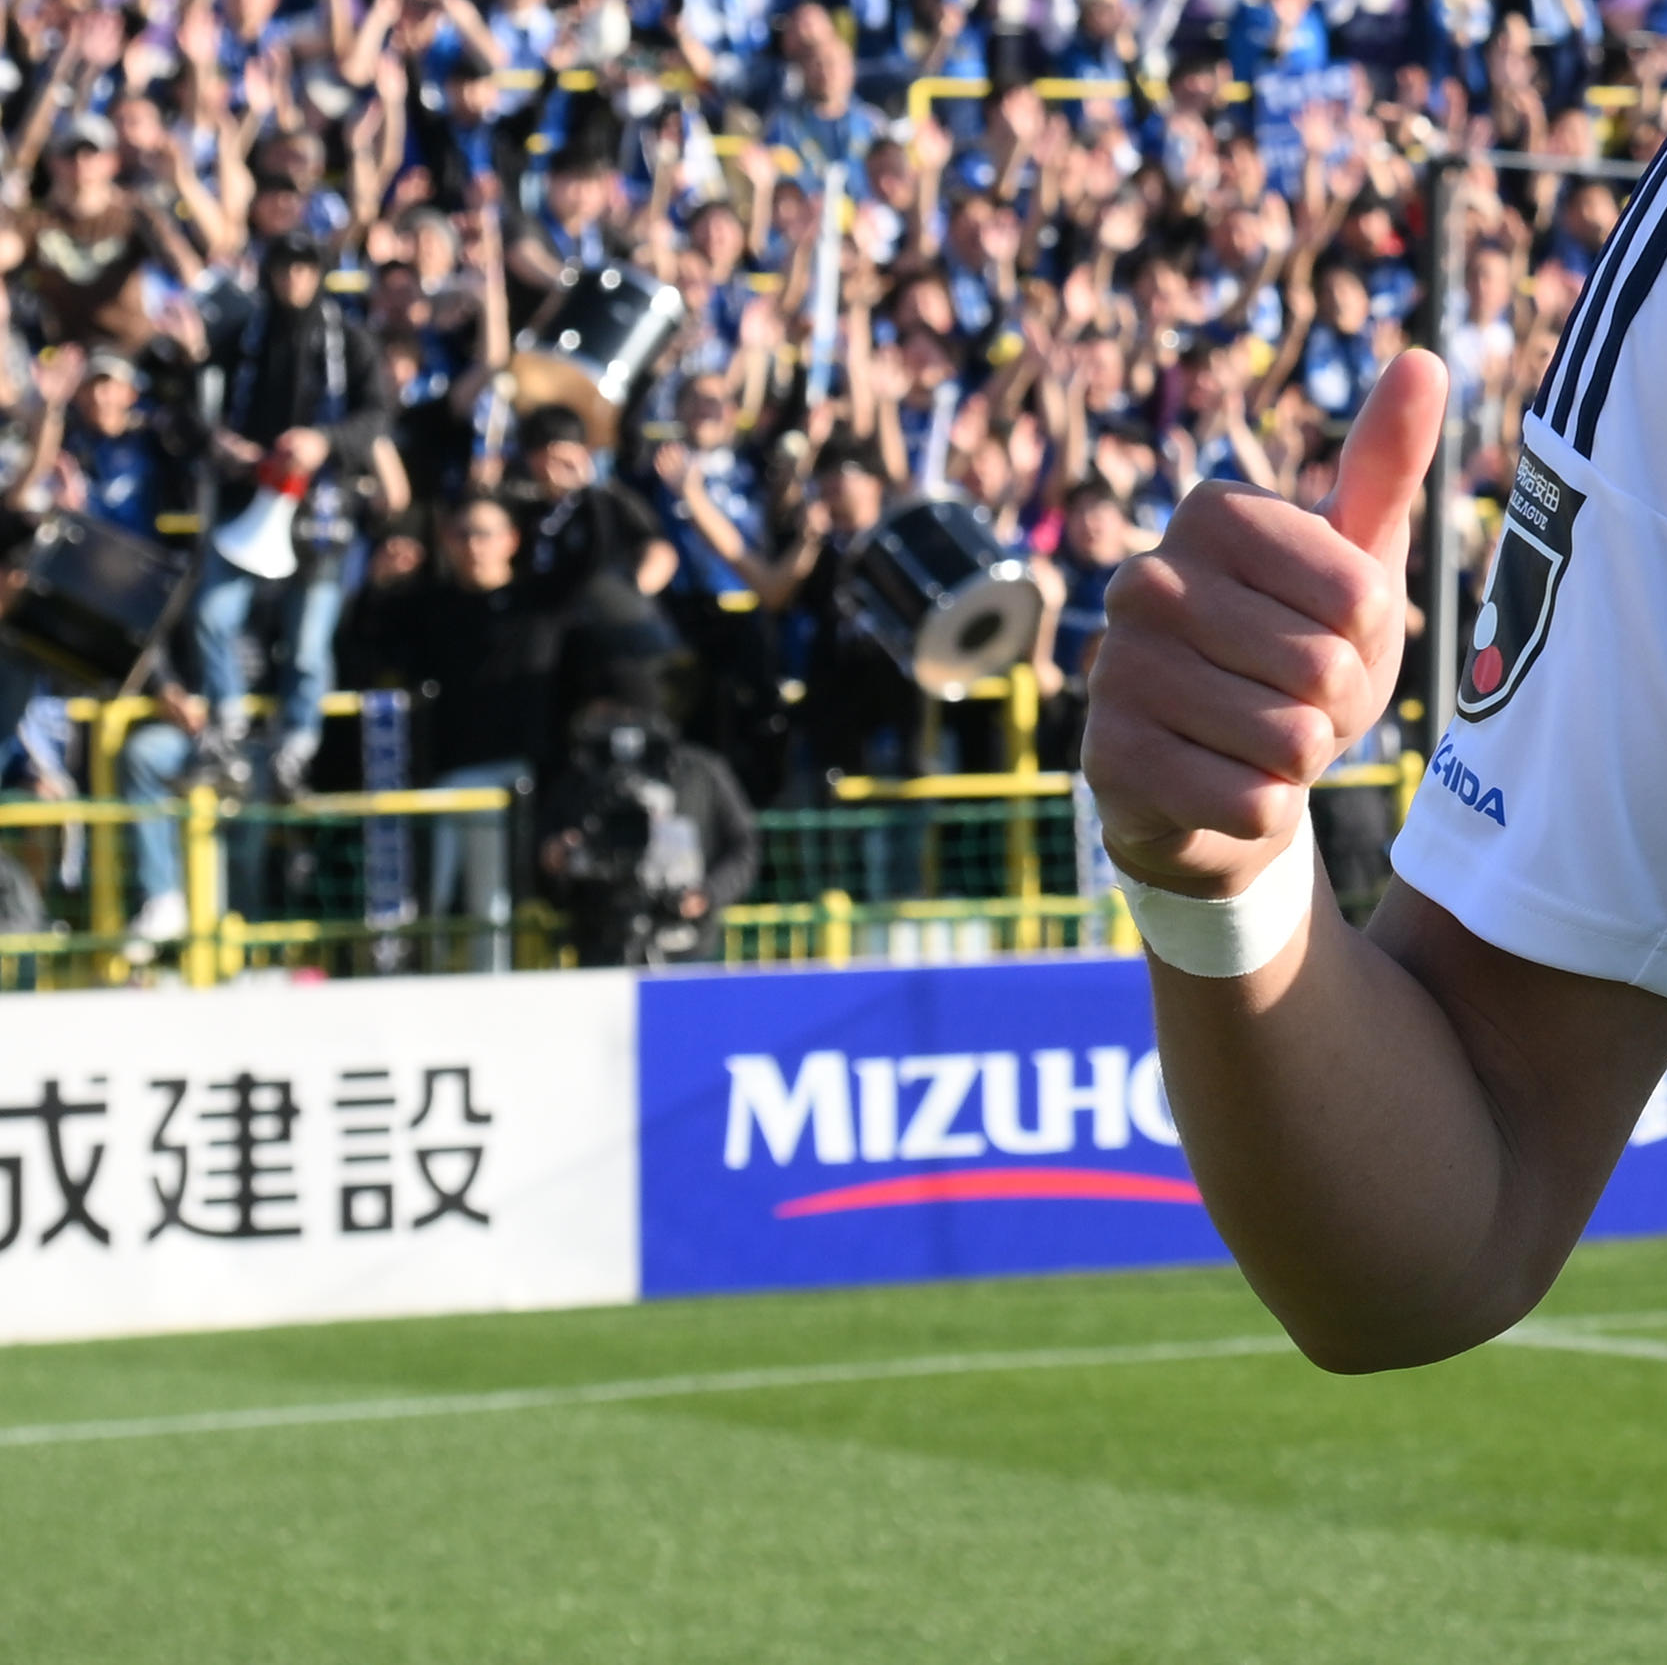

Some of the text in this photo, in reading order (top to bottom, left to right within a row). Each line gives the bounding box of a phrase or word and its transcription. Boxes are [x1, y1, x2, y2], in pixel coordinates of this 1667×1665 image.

[1430, 733, 1507, 828] CHIDA
[0, 1065, 494, 1249] 成建設
